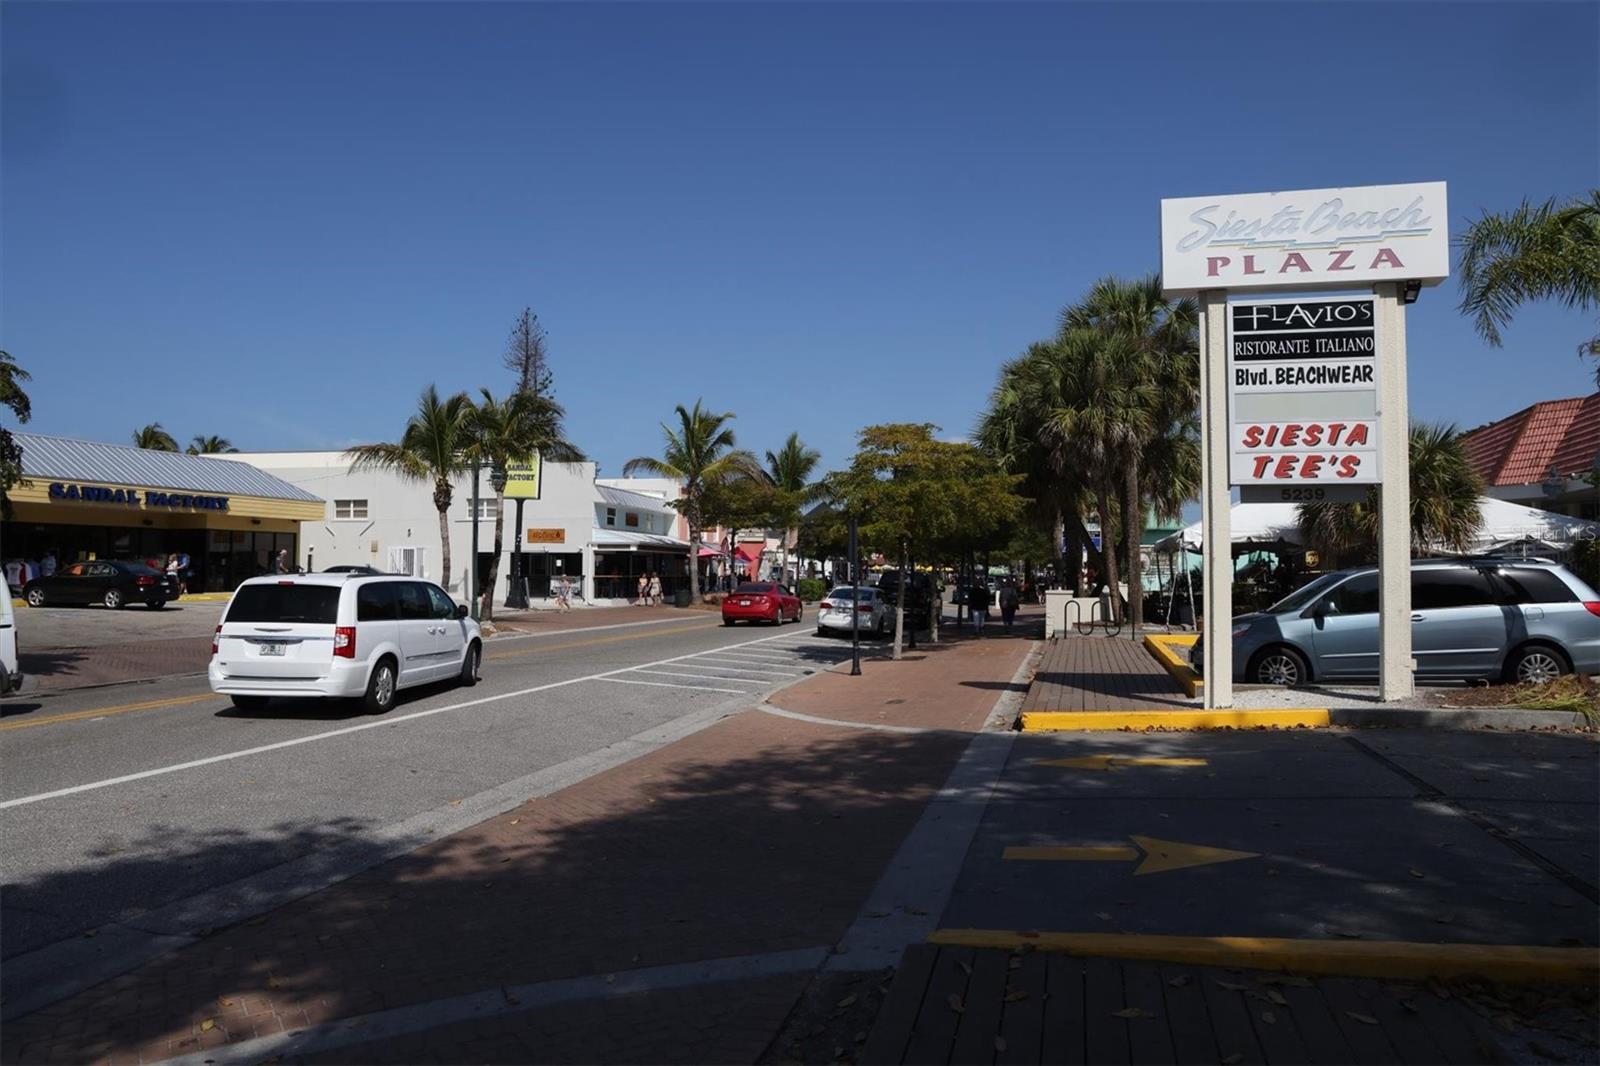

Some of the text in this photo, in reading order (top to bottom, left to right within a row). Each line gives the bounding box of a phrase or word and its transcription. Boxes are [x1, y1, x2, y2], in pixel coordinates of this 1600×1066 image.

[1176, 197, 1432, 253] Siesta Beach
[1207, 248, 1405, 277] PLAZA
[1234, 304, 1371, 330] FLAVIO'S
[1235, 337, 1374, 356] RISTORANTE ITALIANO
[1235, 364, 1374, 386] Blvd. BEACHWEAR
[1242, 423, 1369, 448] SIESTA
[507, 464, 533, 472] SANDAL
[1252, 454, 1361, 480] TEE'S
[48, 482, 231, 512] SANDAL FACTORY
[1280, 487, 1326, 502] 5239
